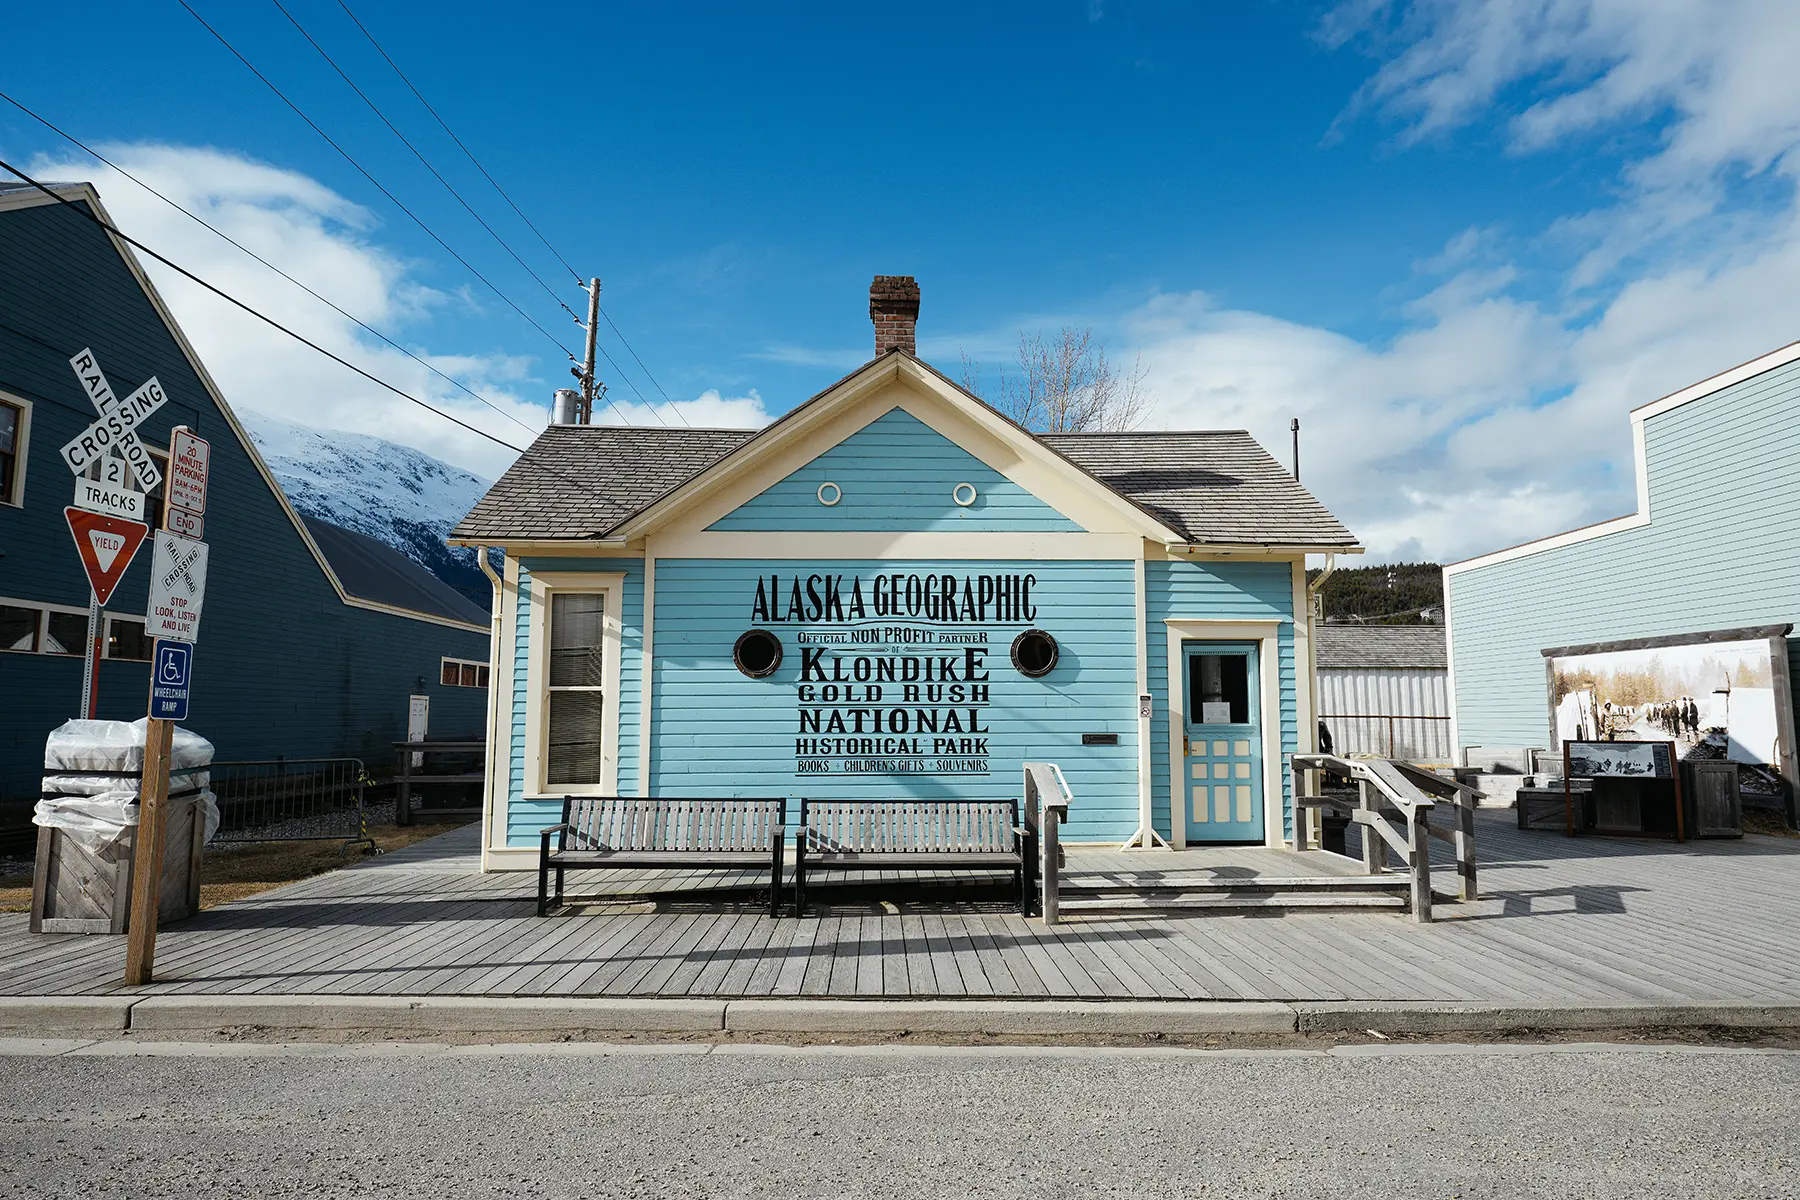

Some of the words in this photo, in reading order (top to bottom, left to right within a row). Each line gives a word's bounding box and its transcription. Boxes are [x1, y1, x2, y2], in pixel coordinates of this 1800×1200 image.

[68, 384, 163, 466] CROSSING
[76, 354, 112, 415] RAIL
[120, 432, 156, 485] ROAD
[186, 446, 197, 457] 20
[178, 453, 203, 472] MINUTE
[107, 463, 119, 482] 2
[175, 463, 205, 483] PARKING
[86, 486, 136, 512] TRACKS
[176, 516, 195, 530] END
[94, 536, 119, 551] YIELD
[164, 549, 198, 587] CROSSING
[166, 541, 181, 564] RAIL
[183, 572, 196, 594] ROAD
[170, 596, 188, 608] STOP
[751, 574, 866, 622] ALASKA
[873, 573, 1036, 622] GEOGRAPHIC
[155, 606, 177, 619] LOOK,
[177, 610, 197, 622] LISTEN
[161, 620, 177, 631] AND
[177, 623, 190, 633] LIVE
[850, 629, 880, 644] NON
[884, 626, 935, 644] PROFIT
[798, 647, 990, 683] KLONDIKE
[154, 687, 187, 699] WHEELCHAIR
[798, 684, 882, 702] GOLD
[902, 684, 990, 702] RUSH
[161, 701, 177, 712] RAMP
[798, 708, 990, 734] NATIONAL
[795, 738, 923, 755] HISTORICAL
[932, 738, 990, 755] PARK
[797, 760, 830, 772] BOOKS
[844, 760, 896, 772] CHILDREN'S
[898, 760, 925, 772] GIFTS
[936, 759, 989, 772] SOUVENIRS
